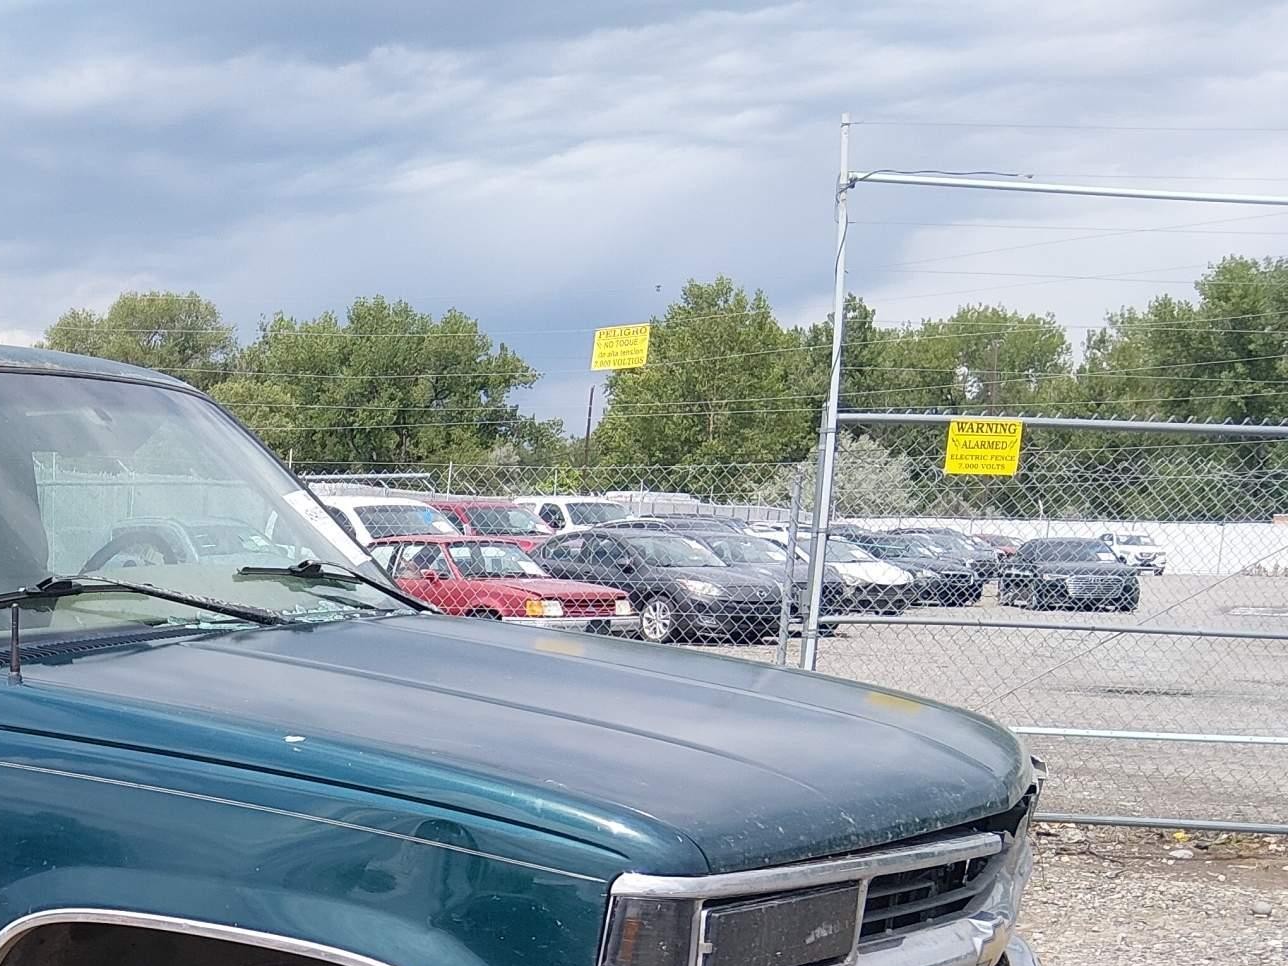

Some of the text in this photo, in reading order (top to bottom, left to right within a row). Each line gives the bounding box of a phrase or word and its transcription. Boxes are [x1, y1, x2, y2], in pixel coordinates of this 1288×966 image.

[599, 326, 647, 338] PELIGRO
[604, 339, 638, 350] NO TOQUE
[957, 421, 1017, 434] WARNING
[961, 440, 1008, 450] ALARMED
